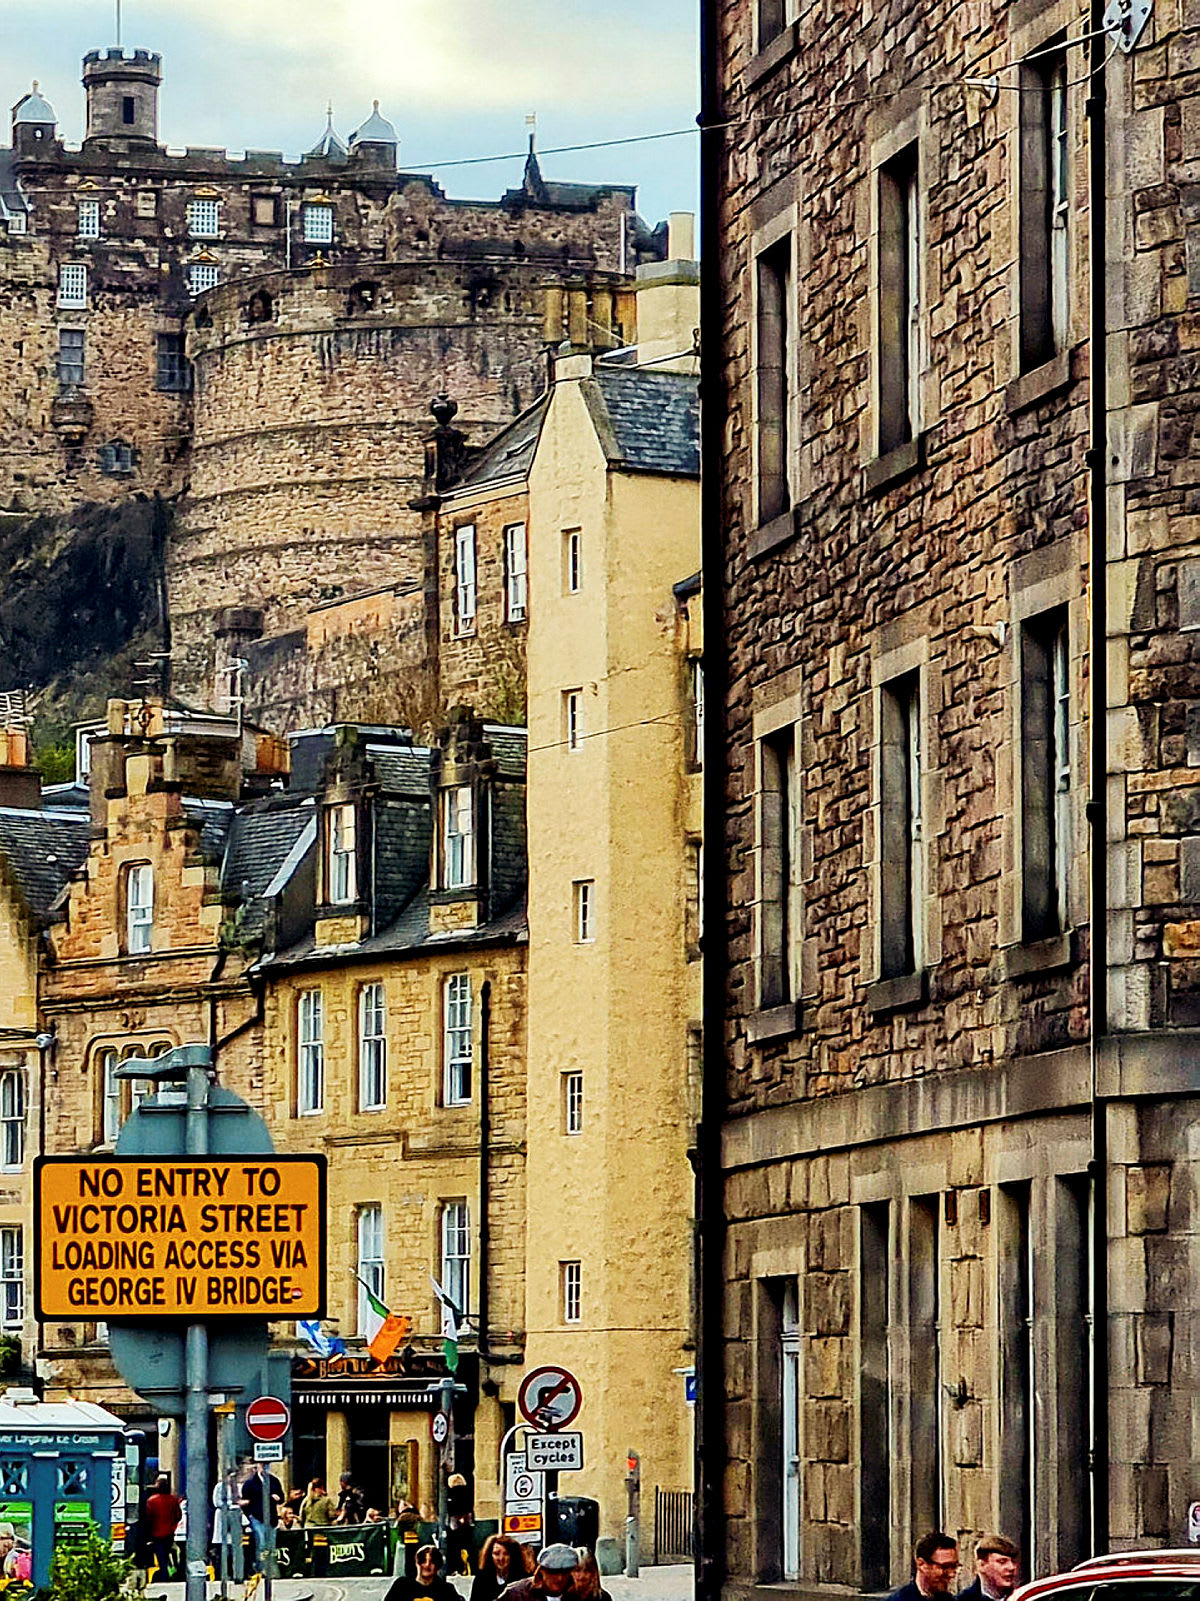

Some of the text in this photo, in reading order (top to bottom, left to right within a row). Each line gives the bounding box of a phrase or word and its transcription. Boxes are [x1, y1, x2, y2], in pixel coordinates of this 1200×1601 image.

[79, 1168, 281, 1197] NO ENTRY TO
[53, 1204, 308, 1233] VICTORIA STREET
[52, 1240, 308, 1270] LOADING ACCESS VIA
[68, 1276, 293, 1306] GEORGE IV BRIDGE
[532, 1438, 577, 1451] Except
[534, 1452, 575, 1466] cycles
